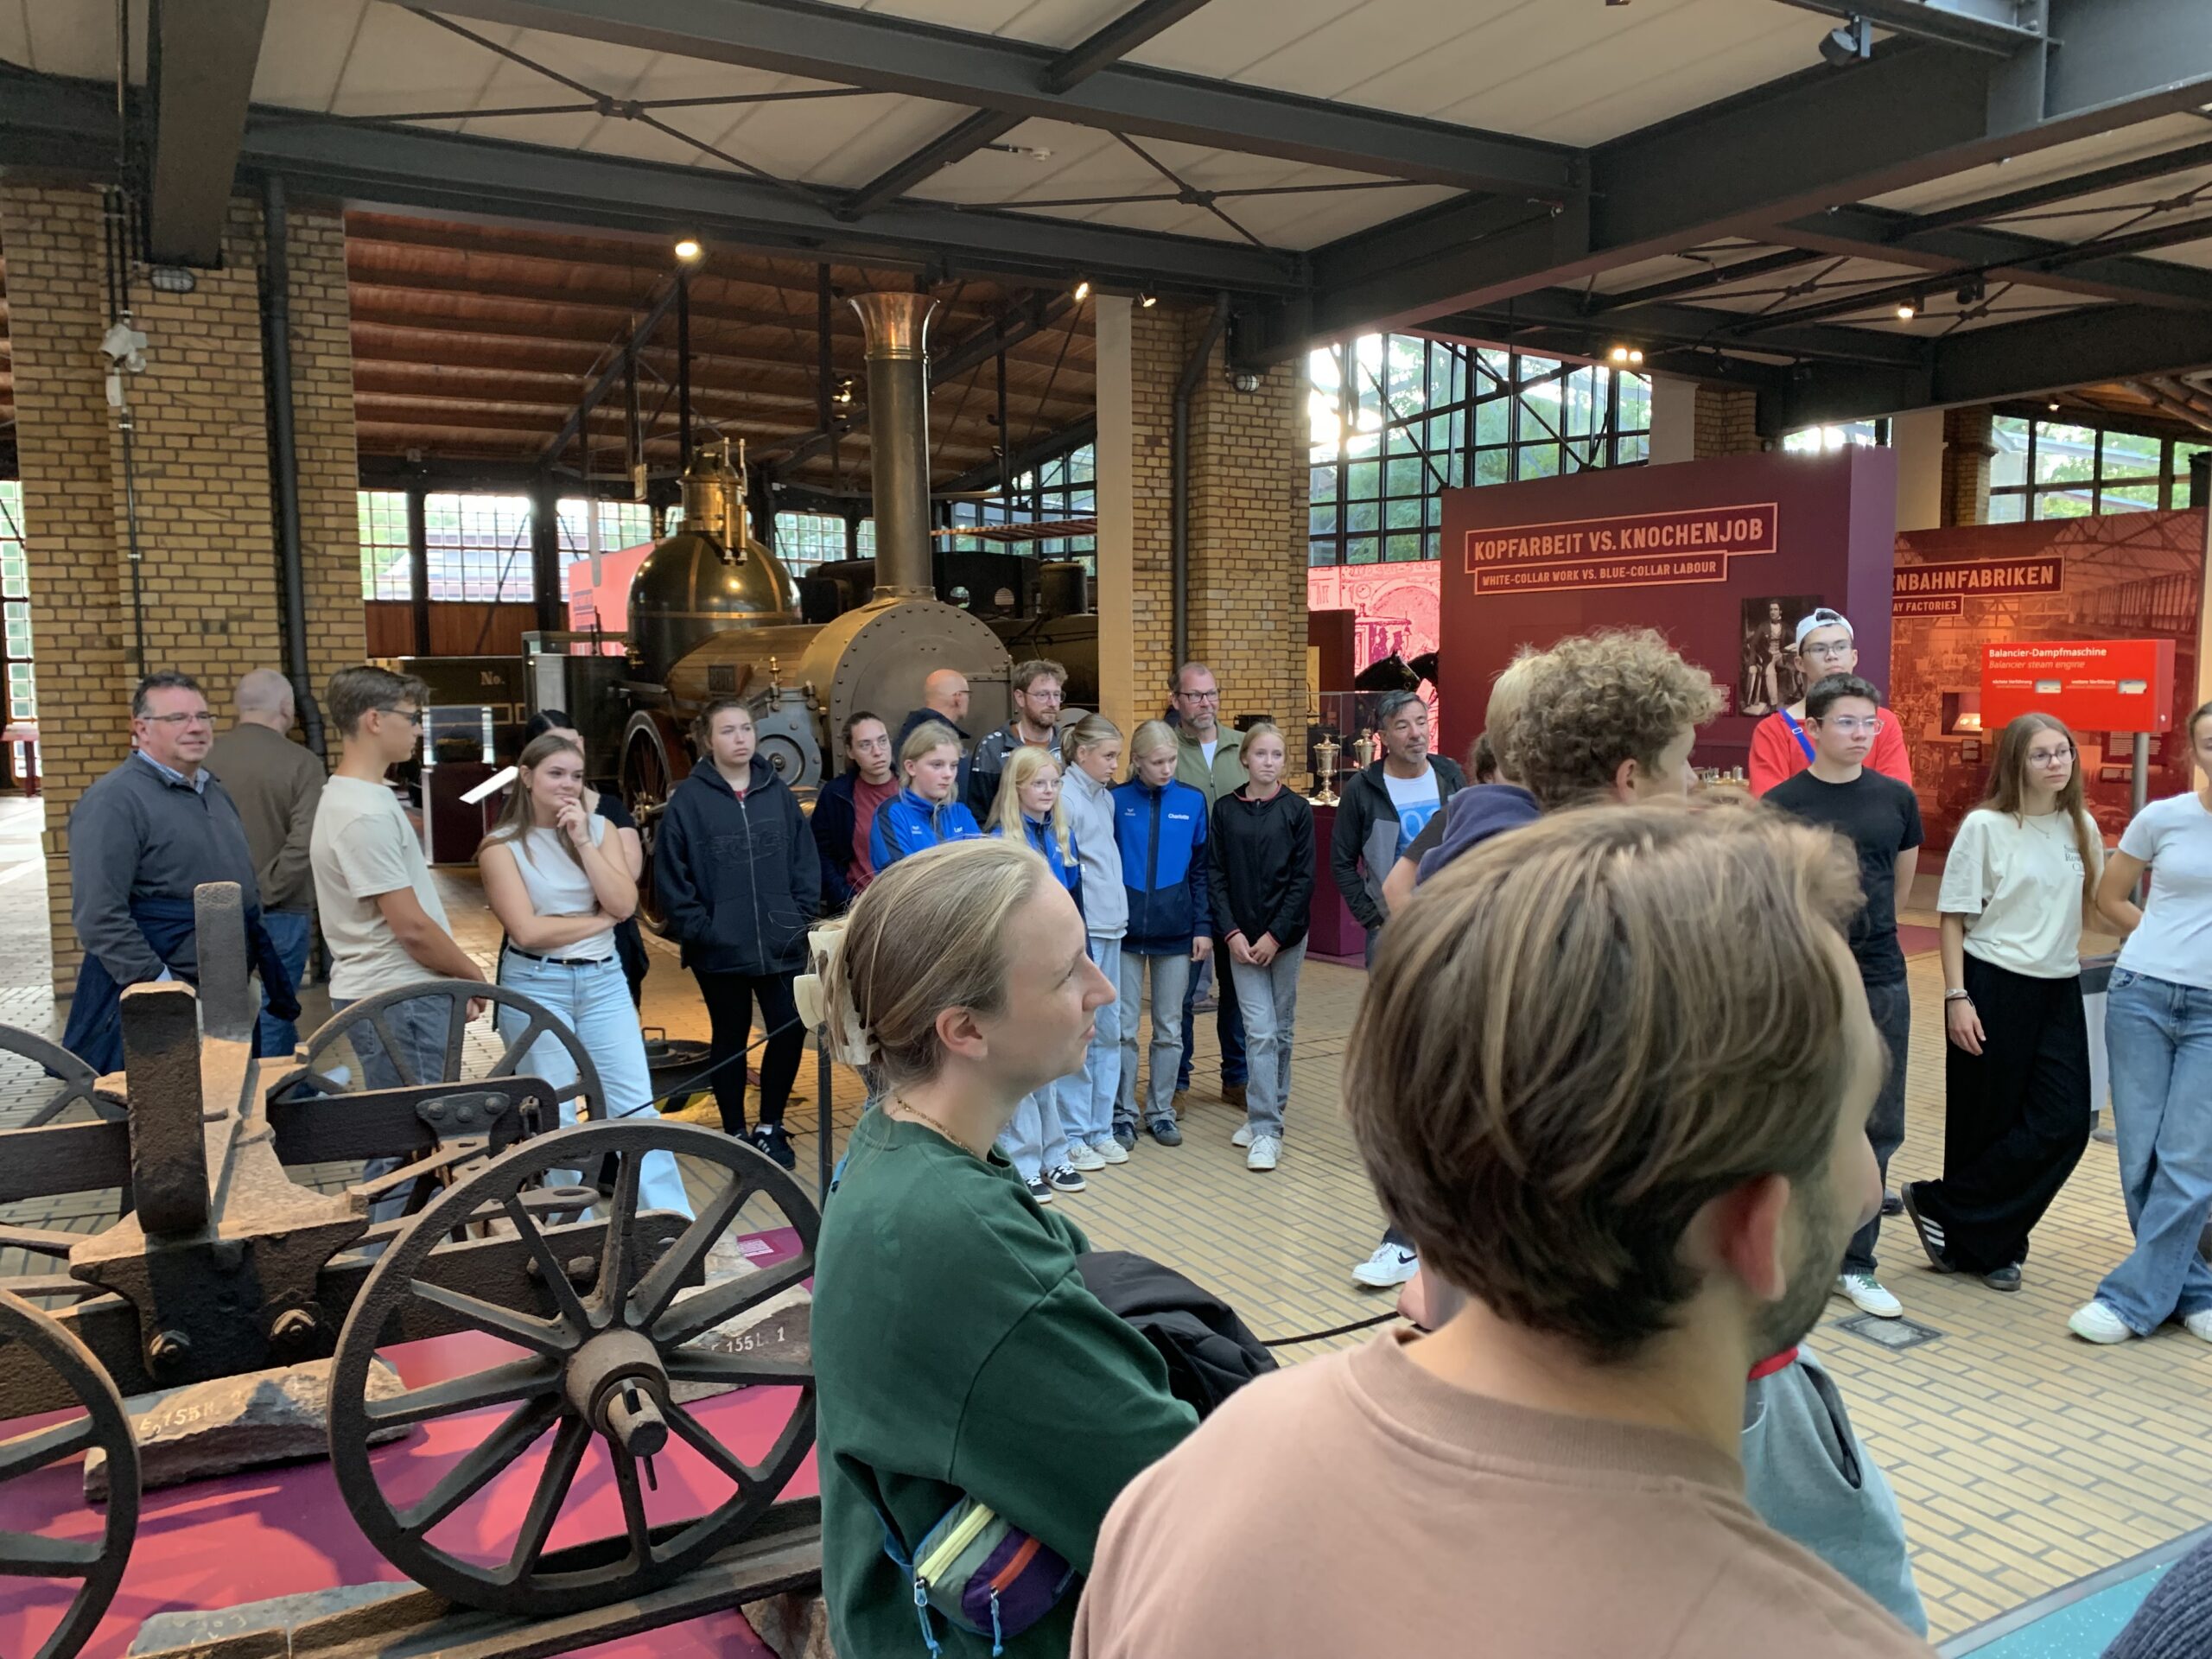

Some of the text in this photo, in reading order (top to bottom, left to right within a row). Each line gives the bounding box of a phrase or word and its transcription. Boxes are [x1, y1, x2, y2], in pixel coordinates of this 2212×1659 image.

[1474, 518, 1764, 561] KOPFARBEIT VS. KNOCHENJOB
[1482, 561, 1716, 587] WHITE-COLLAR WORK VS. BLUE-COLLAR LABOUR
[1892, 565, 2054, 591] NBAHNFABRIKEN
[1905, 600, 1957, 612] FACTORIES
[1989, 647, 2107, 659] Balancier-Dampfmaschine
[1988, 660, 2026, 669] Balancier
[2055, 661, 2085, 671] engine
[480, 671, 505, 685] No.
[777, 1326, 785, 1342] 1
